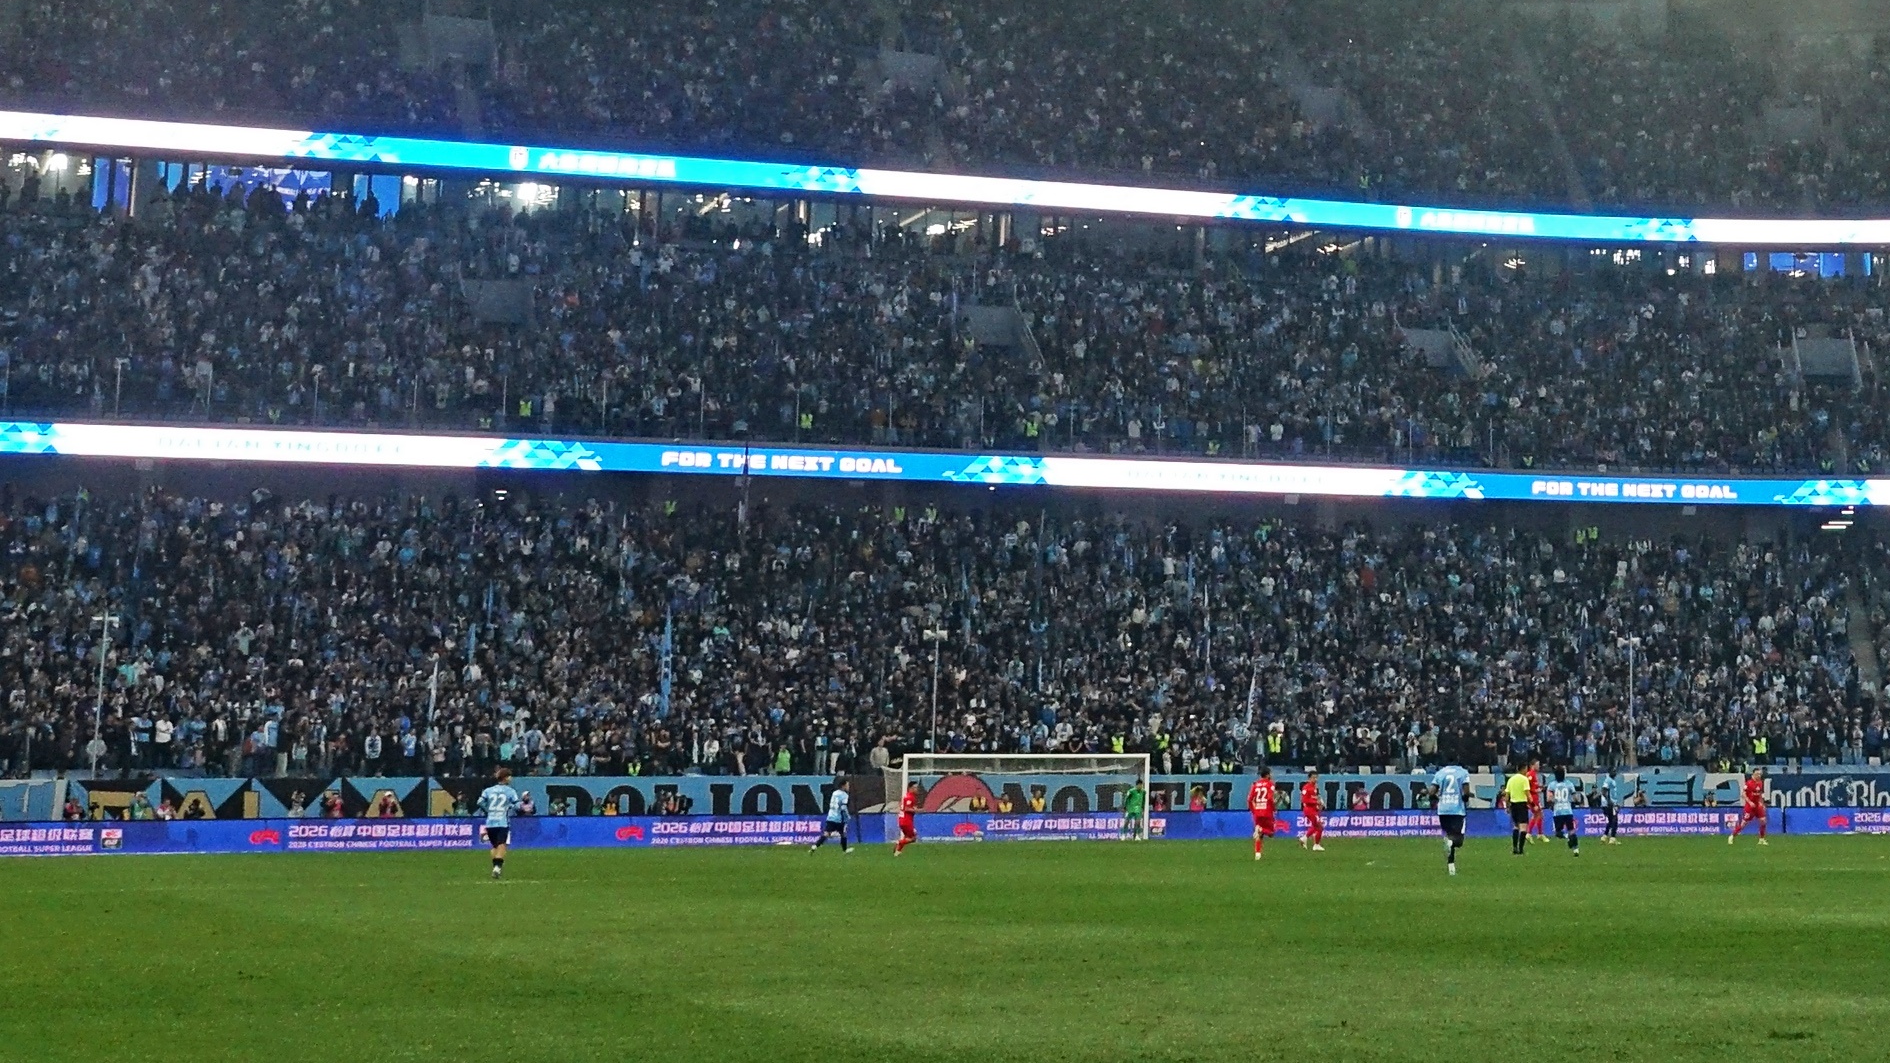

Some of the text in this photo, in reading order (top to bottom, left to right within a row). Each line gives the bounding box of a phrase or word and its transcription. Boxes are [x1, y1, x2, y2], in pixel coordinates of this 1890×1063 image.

[661, 450, 903, 474] FOR THE NEXT GOAL
[1532, 480, 1738, 499] FOR THE NEXT GOAL
[1446, 774, 1455, 791] 2
[489, 793, 507, 809] 22
[1255, 787, 1268, 803] 22
